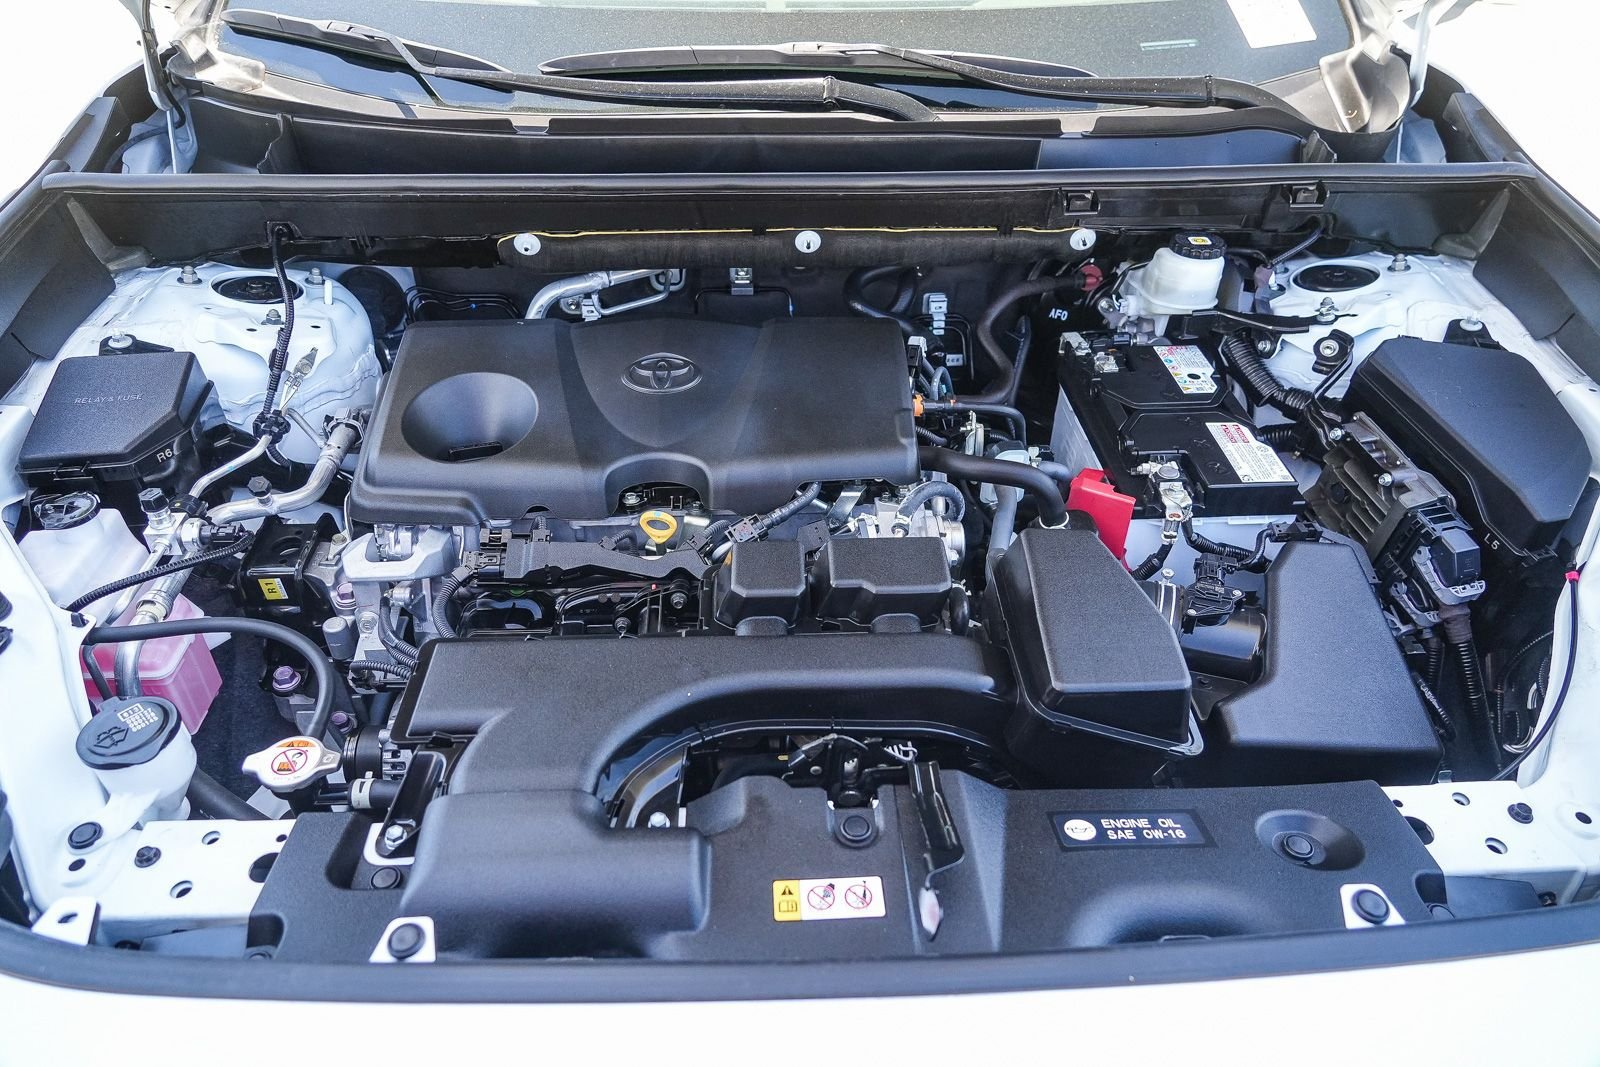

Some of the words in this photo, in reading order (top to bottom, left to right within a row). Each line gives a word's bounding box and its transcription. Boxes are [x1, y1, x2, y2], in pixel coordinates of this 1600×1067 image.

[156, 448, 173, 463] R6
[1100, 818, 1152, 829] ENGINE
[1157, 818, 1182, 828] OIL
[1106, 829, 1137, 840] SAE
